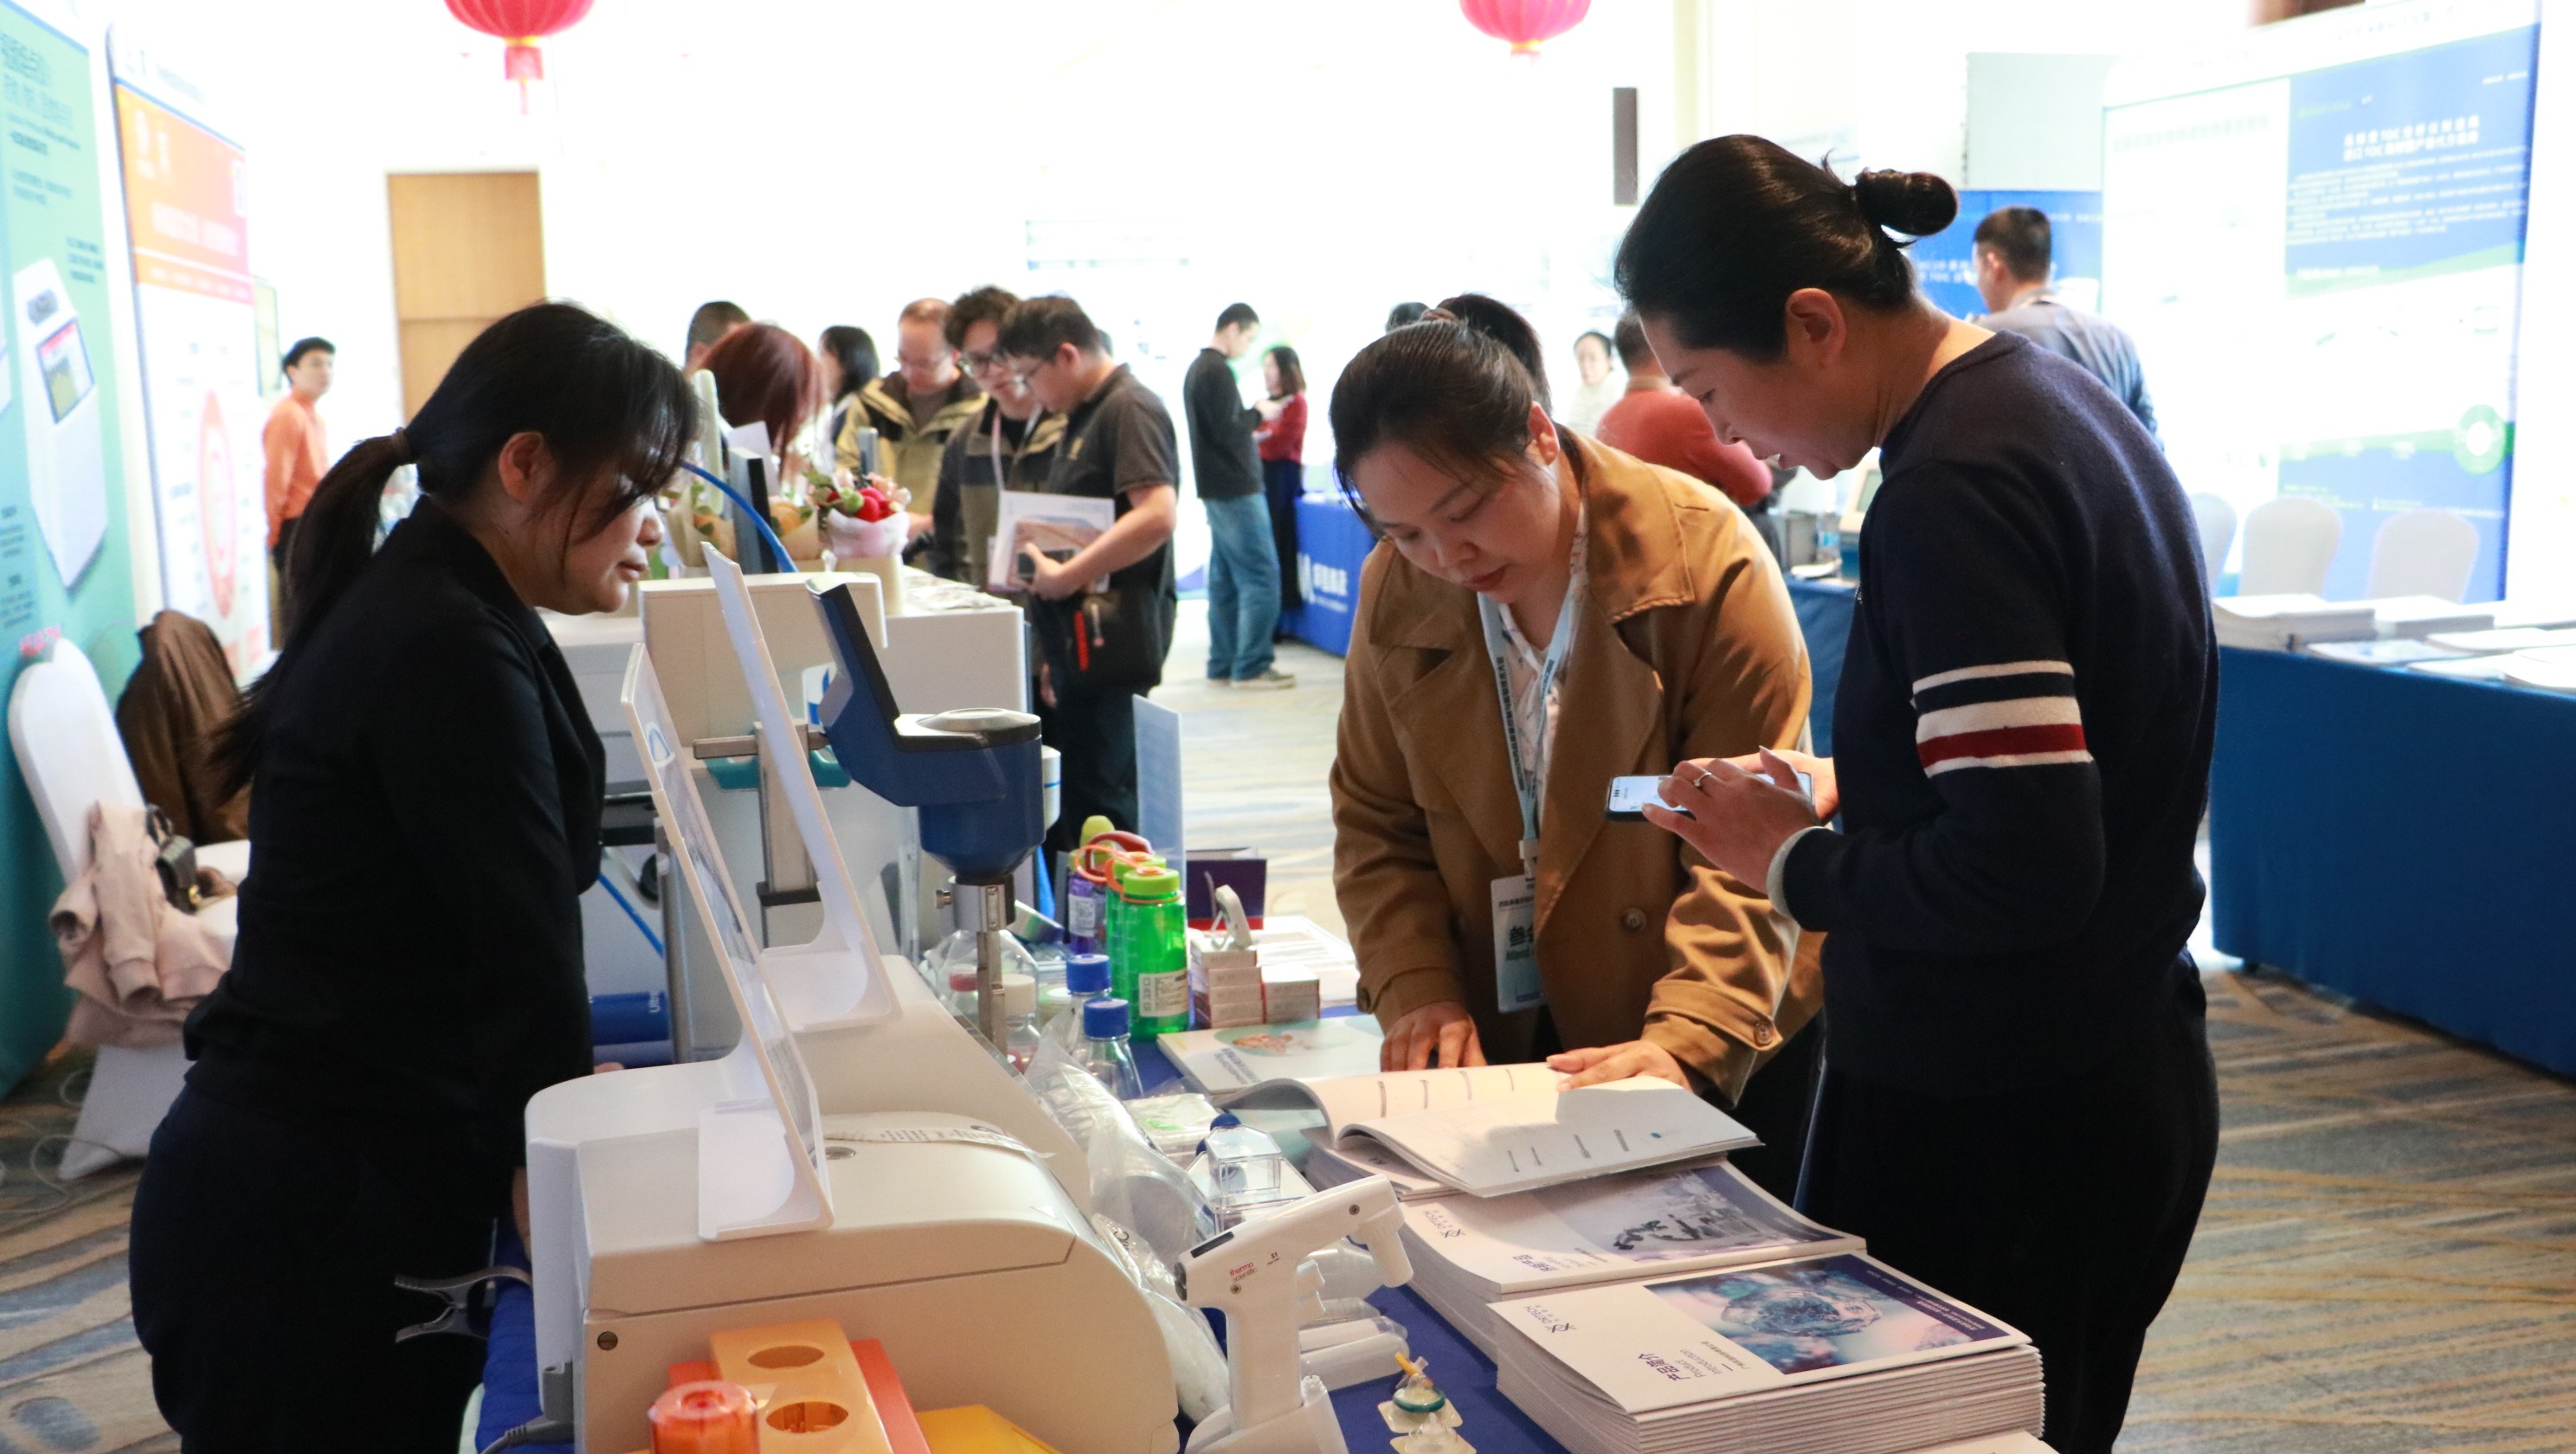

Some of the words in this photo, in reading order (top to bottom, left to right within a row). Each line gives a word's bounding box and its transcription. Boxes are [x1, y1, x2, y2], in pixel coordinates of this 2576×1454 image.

[1229, 1261, 1254, 1277] thermo
[1638, 1353, 1691, 1382] 产品简介
[1675, 1360, 1705, 1377] Product
